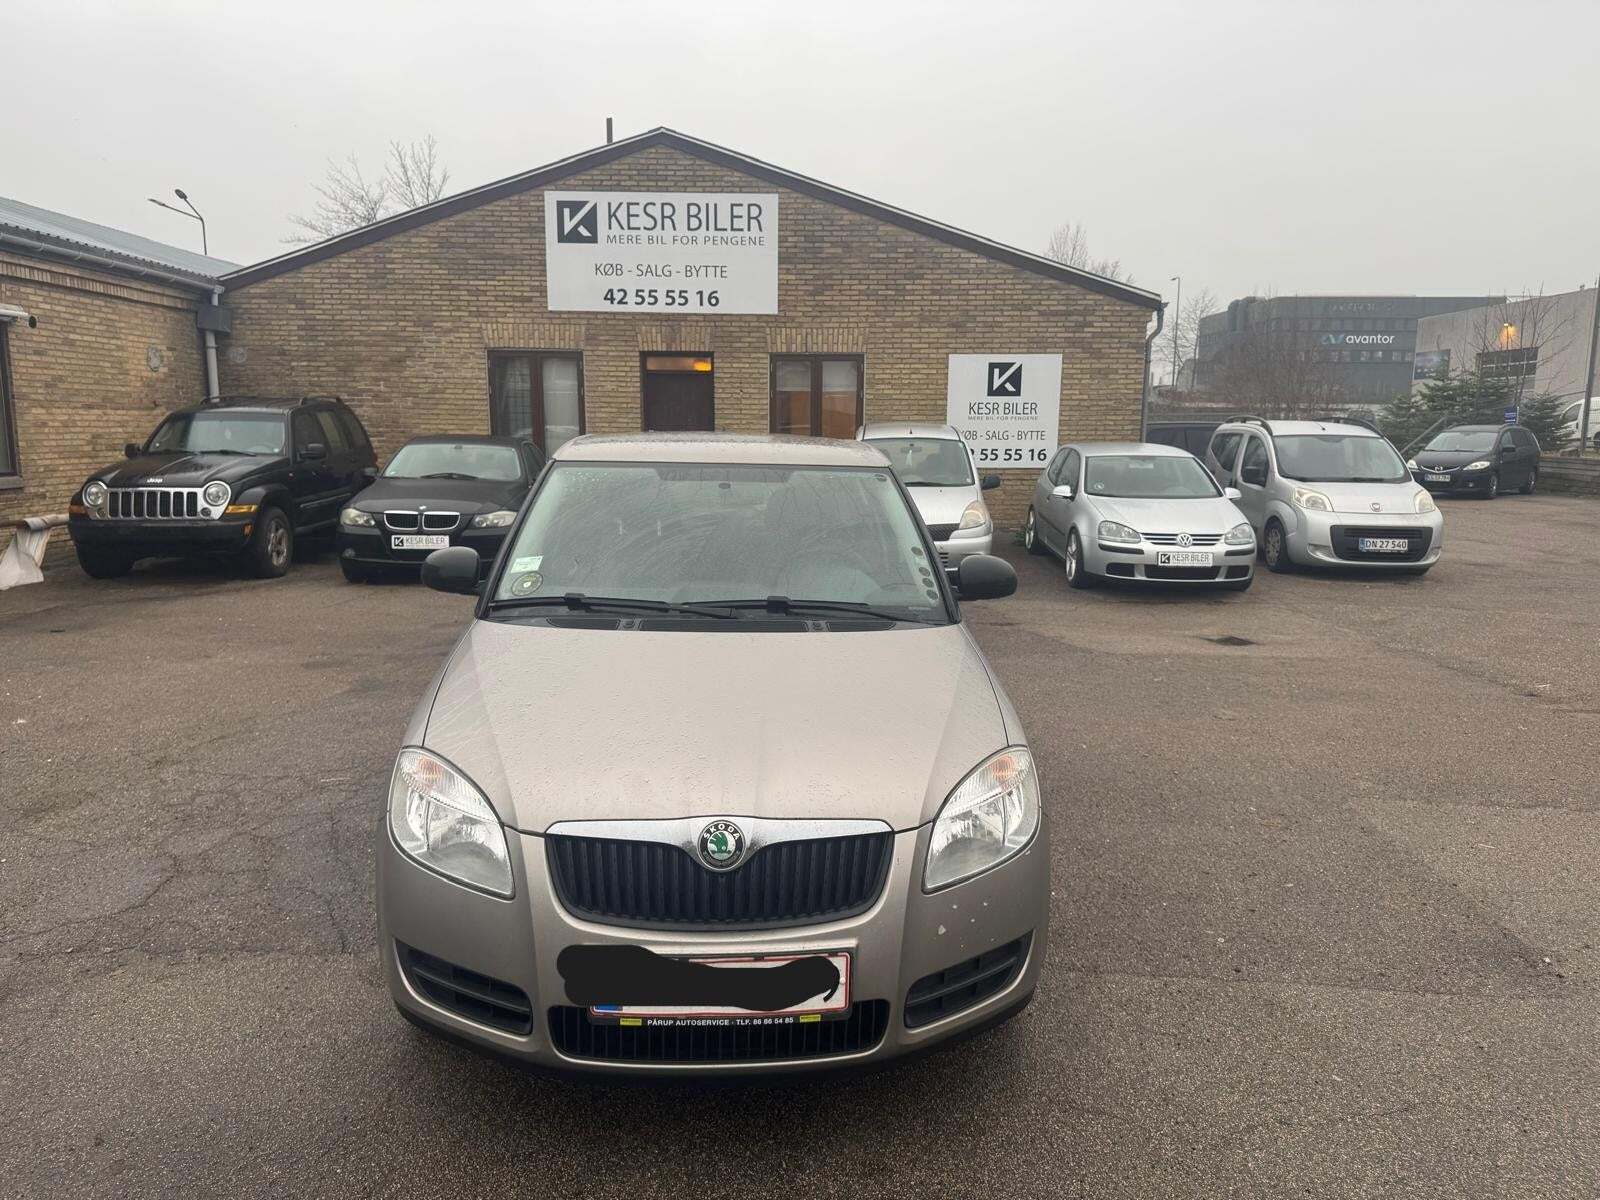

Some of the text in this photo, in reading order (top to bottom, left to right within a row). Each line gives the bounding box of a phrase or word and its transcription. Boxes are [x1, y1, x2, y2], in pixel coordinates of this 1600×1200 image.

[607, 201, 763, 233] KESR BILER
[606, 234, 765, 246] MERE BIL FOR PENGENE
[594, 263, 624, 277] KØB
[636, 263, 672, 278] SALG
[685, 264, 728, 278] BYTTE
[603, 288, 720, 307] 42 55 55 16
[1345, 333, 1396, 344] avantor
[968, 401, 1038, 415] KESR BILER
[985, 430, 1009, 440] SALG
[1017, 430, 1046, 440] BYTTE
[979, 448, 999, 461] 55
[1003, 448, 1022, 461] 55
[1028, 448, 1047, 461] 16
[405, 537, 424, 545] KESR
[1366, 540, 1378, 549] DN
[1379, 540, 1390, 549] 27
[647, 1018, 674, 1026] PÅRUP
